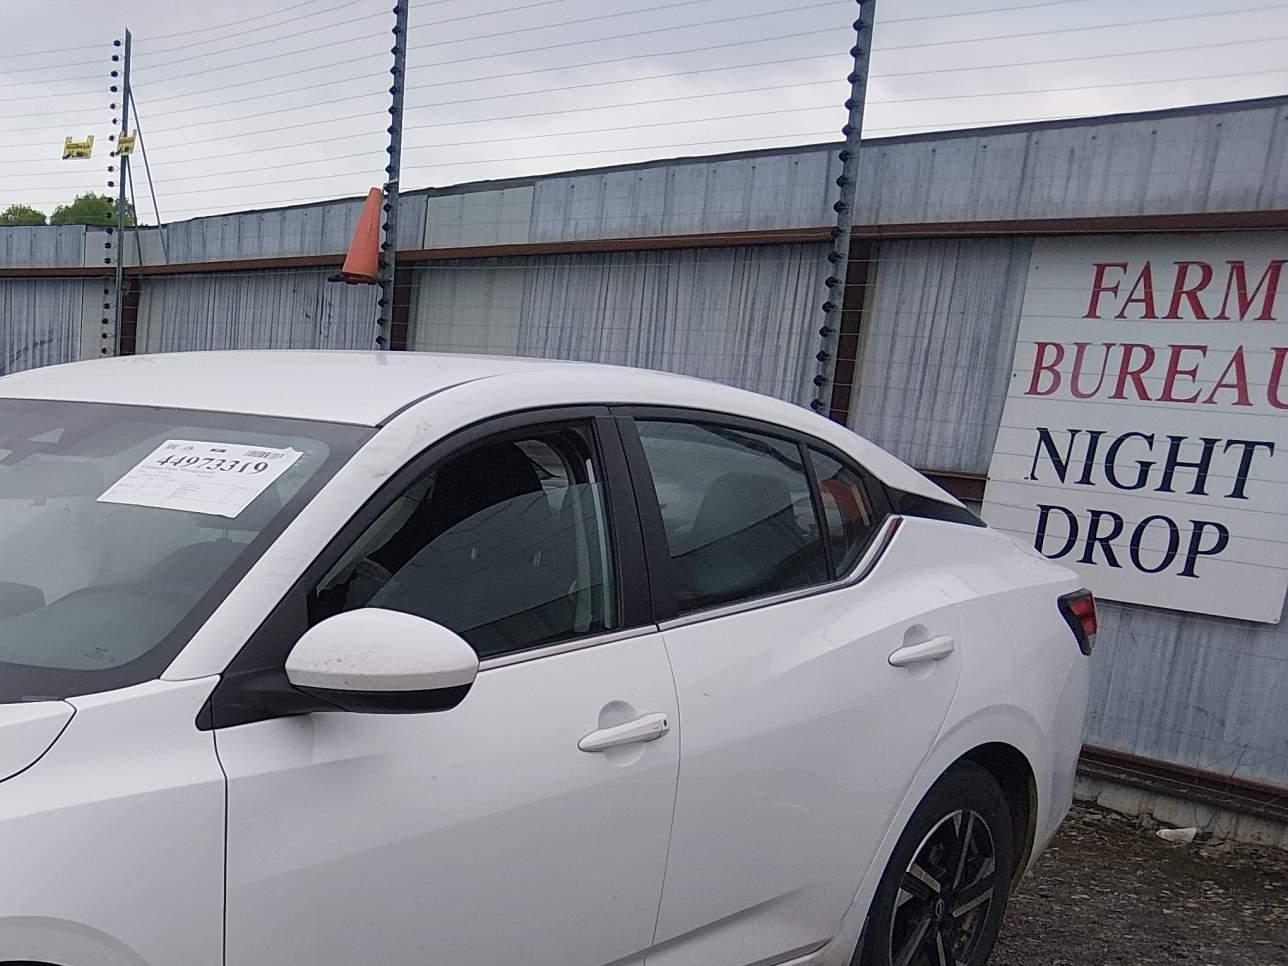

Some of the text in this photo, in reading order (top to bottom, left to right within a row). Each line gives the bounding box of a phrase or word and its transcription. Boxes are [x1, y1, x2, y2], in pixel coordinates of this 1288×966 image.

[1081, 259, 1288, 321] FARM
[156, 454, 269, 475] 44973319
[1024, 427, 1275, 500] NIGHT
[1033, 503, 1230, 578] DROP
